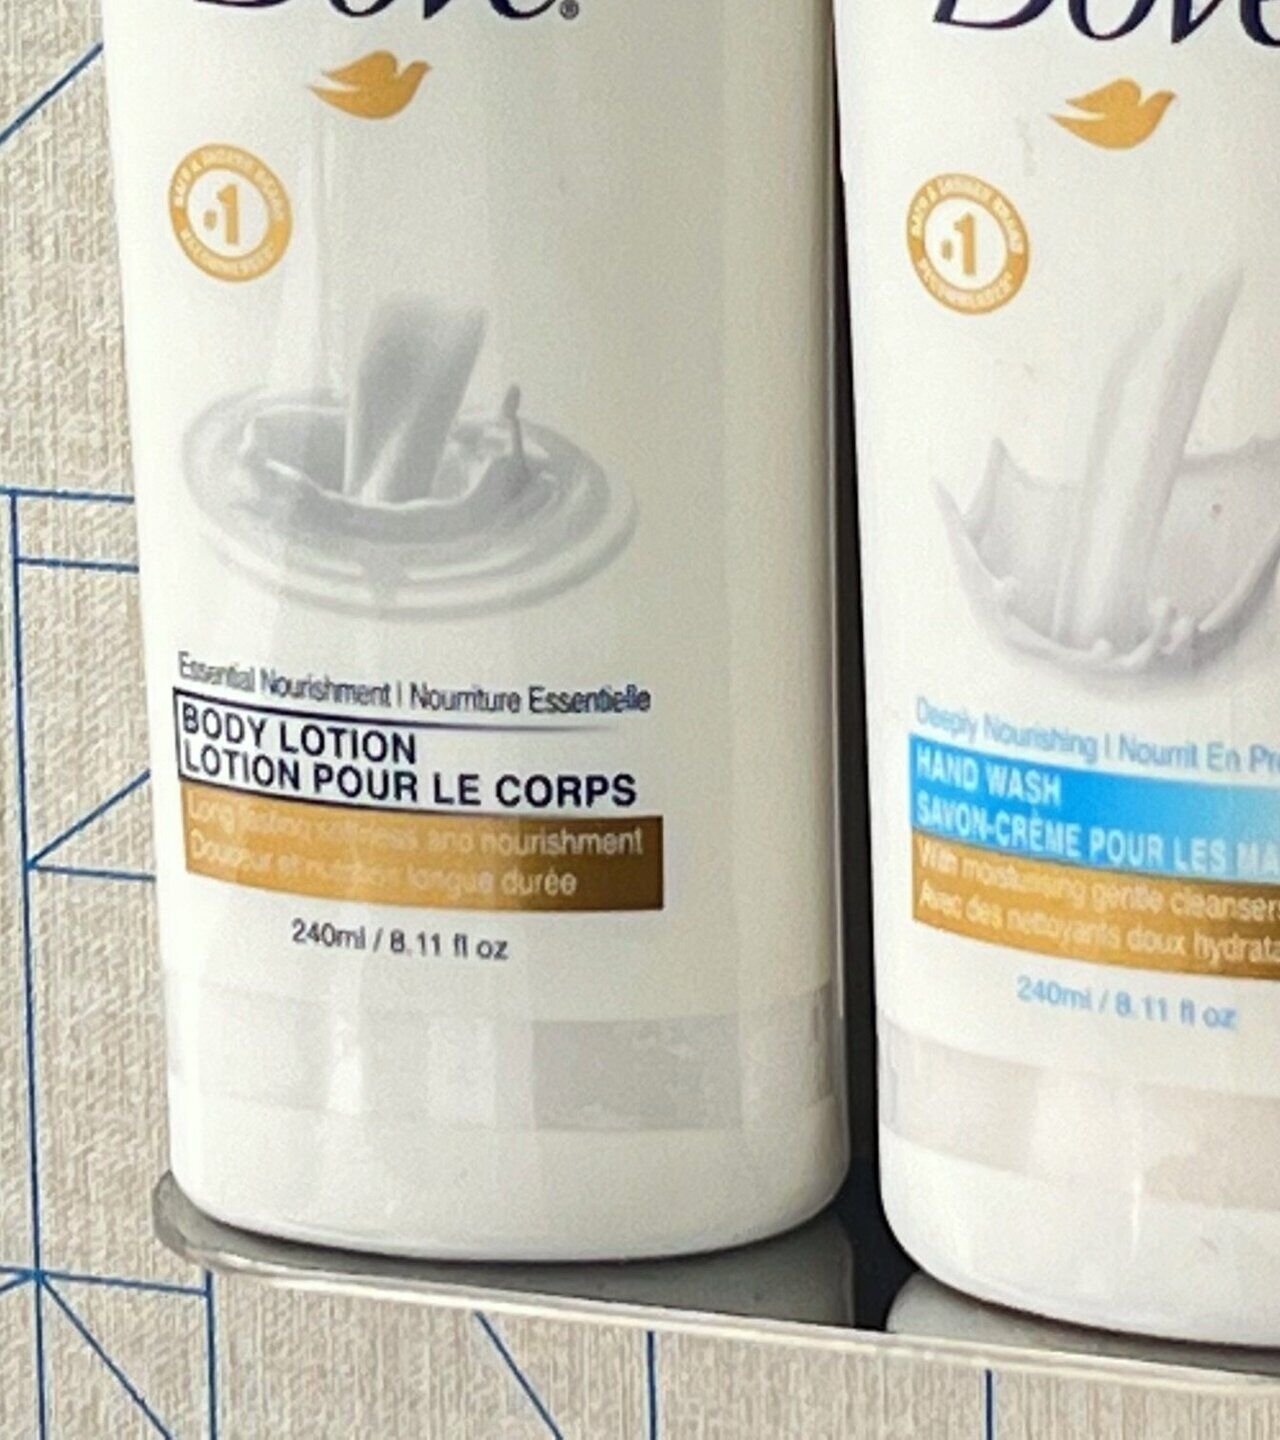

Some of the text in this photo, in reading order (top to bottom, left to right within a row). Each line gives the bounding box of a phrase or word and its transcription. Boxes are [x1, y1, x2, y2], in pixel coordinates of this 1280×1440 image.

[178, 651, 255, 693] Essential
[261, 668, 392, 706] Nourishment
[410, 682, 521, 712] Nourriture
[528, 684, 651, 714] Essentielle
[183, 701, 416, 765] BODY LOTION
[984, 713, 1098, 763] Nourishing
[1207, 741, 1241, 771] En
[185, 740, 637, 808] LOTION POUR LE CORPS
[916, 743, 1062, 806] HAND WASH
[480, 826, 644, 855] nourishment
[917, 791, 1082, 859] SAVON-CRÈME
[1089, 827, 1165, 868] POUR
[1174, 836, 1227, 874] LES
[406, 865, 494, 898] longue
[501, 867, 577, 896] durée
[1092, 882, 1165, 915] gentle
[292, 918, 366, 949] 240ml
[477, 939, 509, 960] oz
[1126, 925, 1186, 955] doux
[1017, 975, 1092, 1009] 240ml
